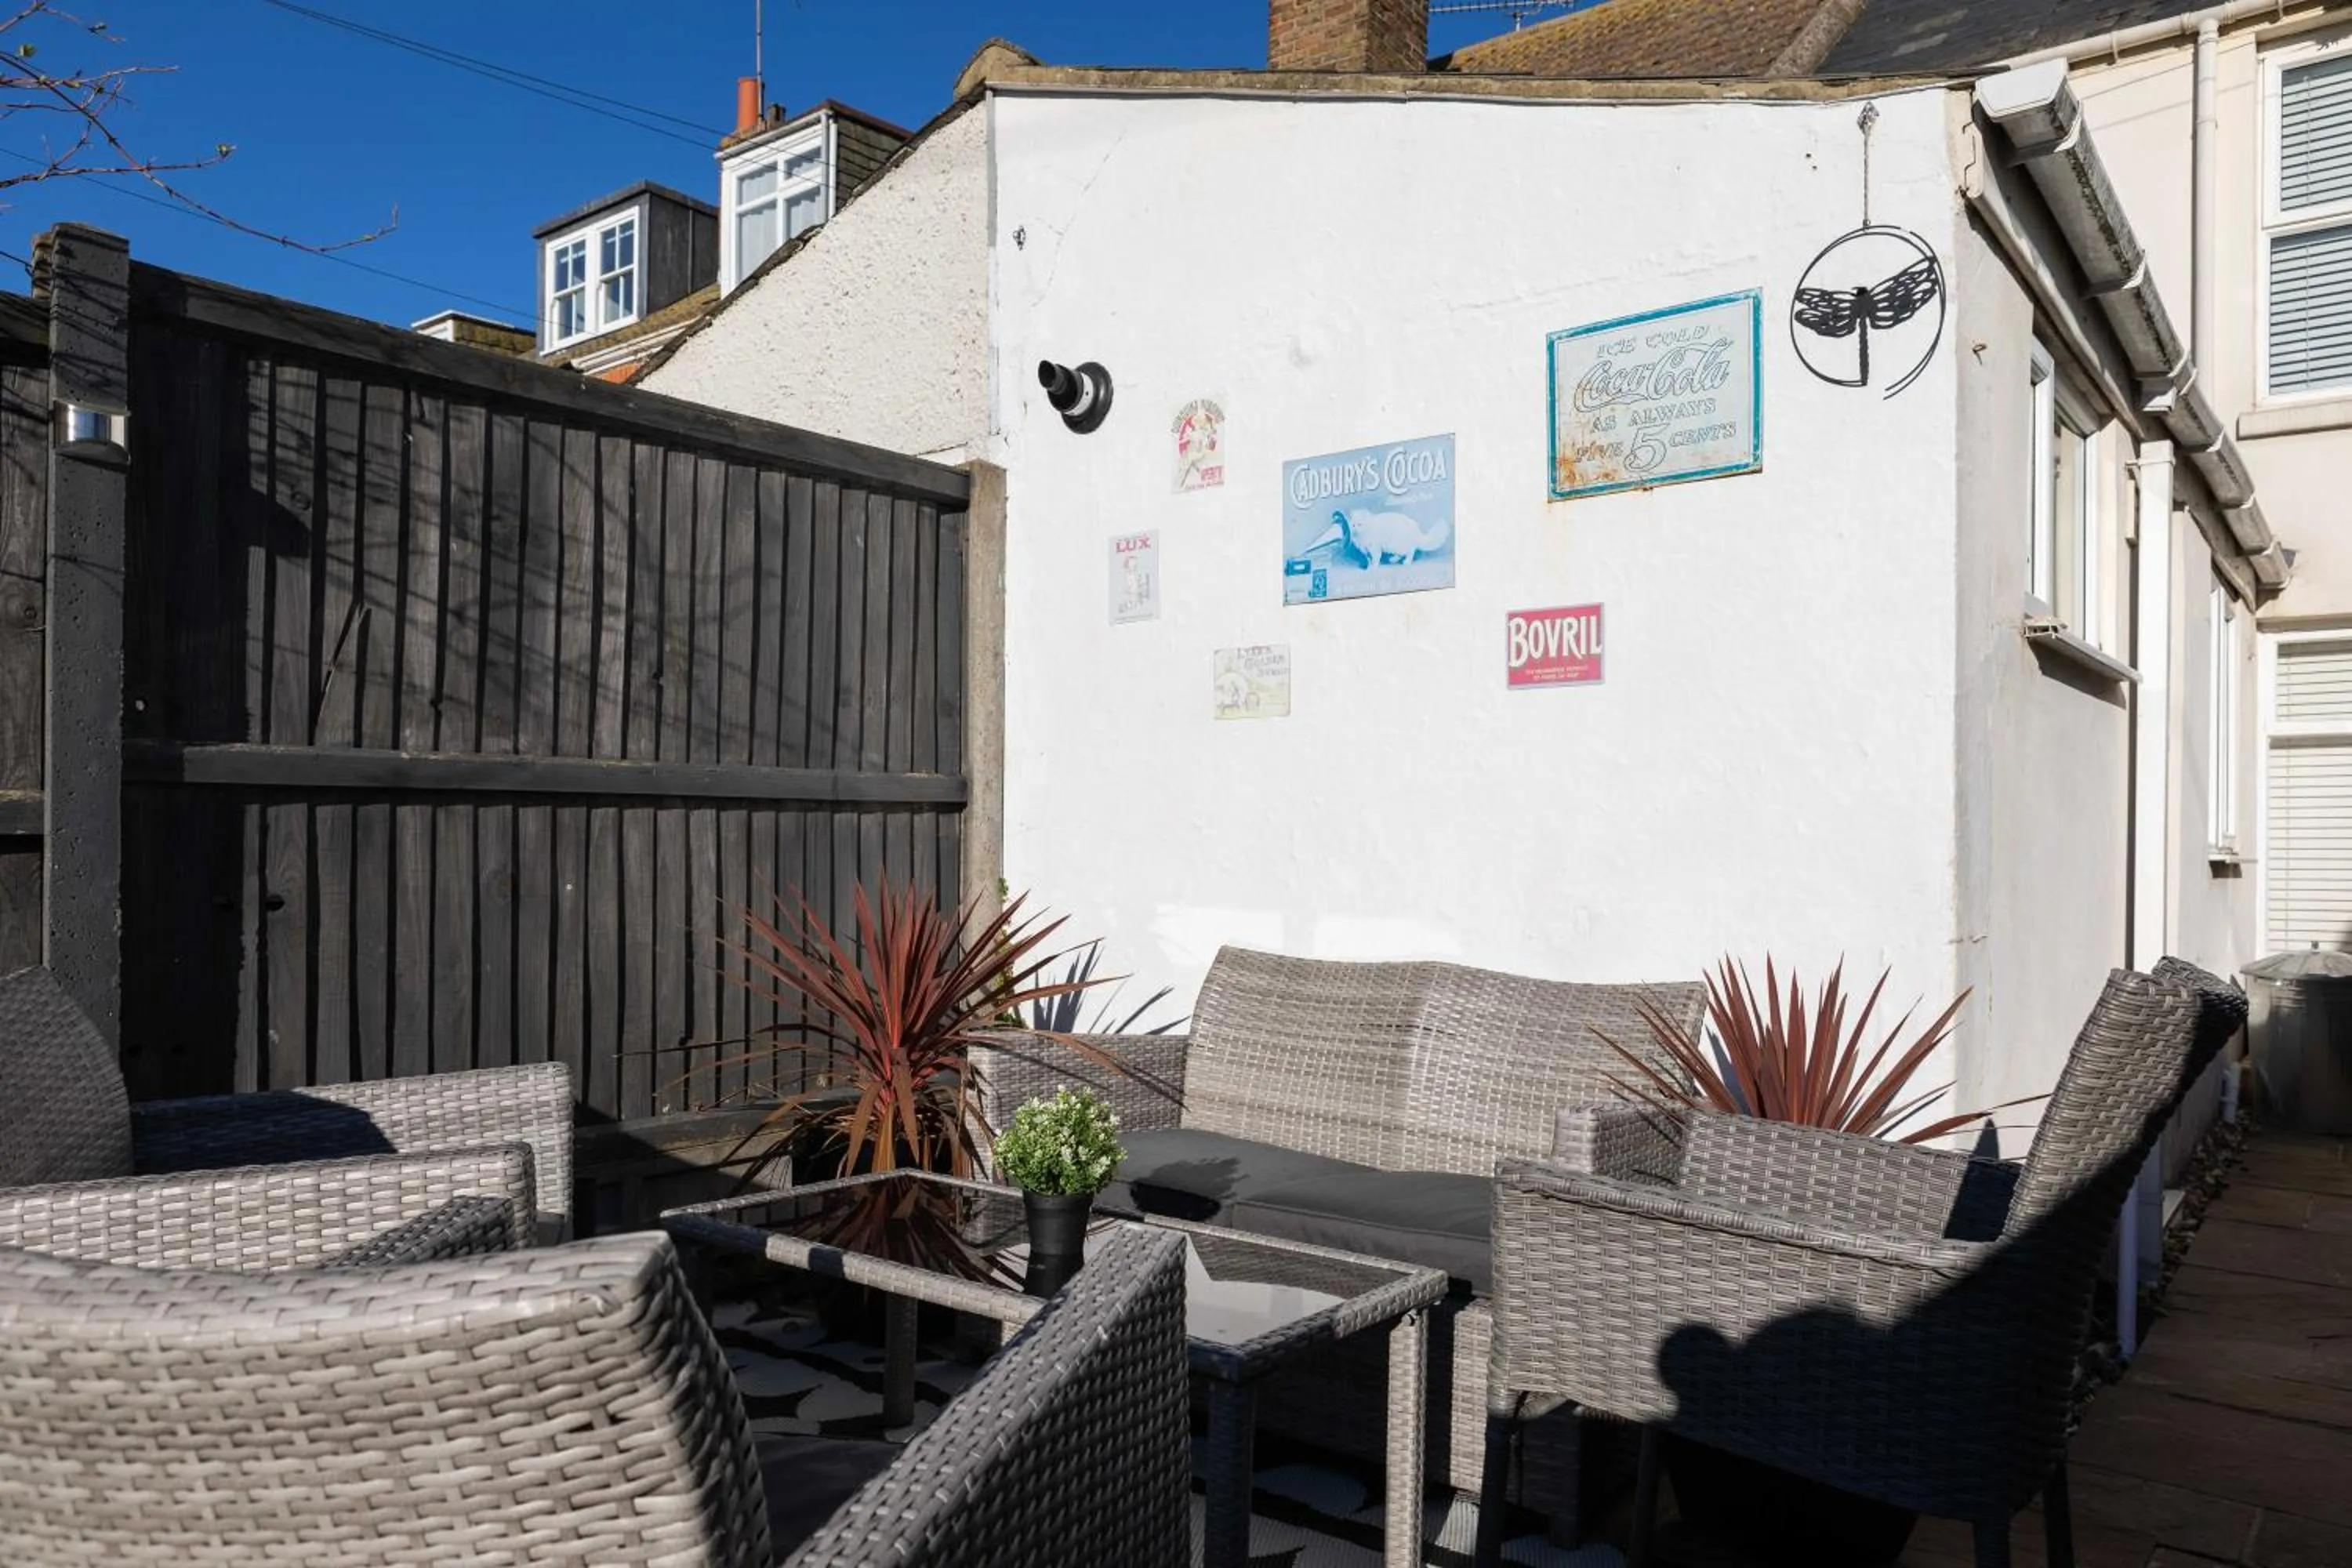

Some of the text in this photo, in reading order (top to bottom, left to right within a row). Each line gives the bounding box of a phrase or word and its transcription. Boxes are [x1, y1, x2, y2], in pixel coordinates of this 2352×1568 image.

[1597, 326, 1709, 358] ICE COLD
[1591, 397, 1717, 434] AS ALWAYS
[1624, 423, 1670, 471] 5
[1668, 422, 1737, 447] CENTS
[1290, 447, 1447, 508] CADBURY'S COCOA
[1116, 535, 1150, 553] LUX
[1508, 615, 1603, 668] BOVRIL
